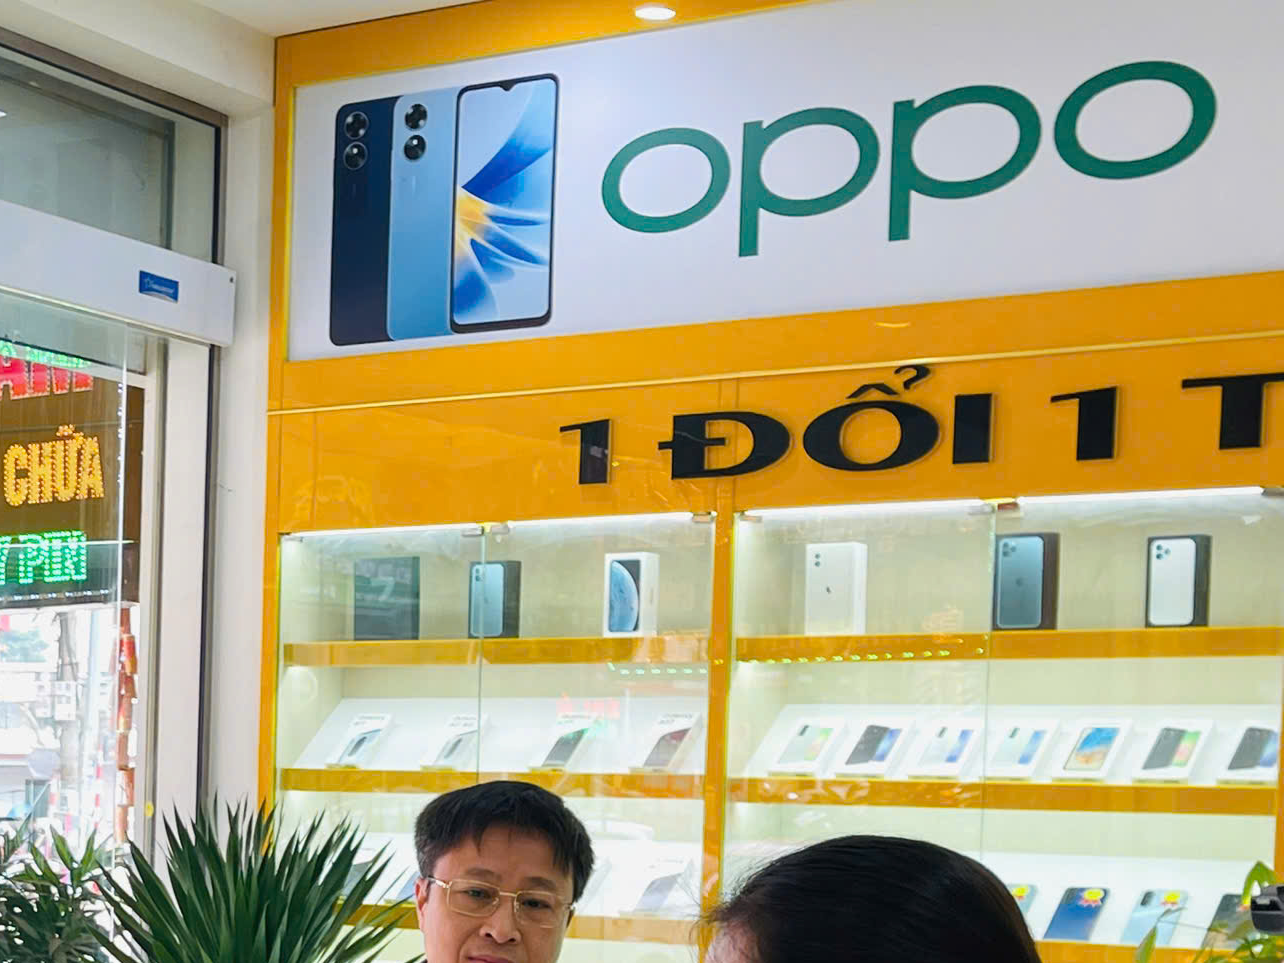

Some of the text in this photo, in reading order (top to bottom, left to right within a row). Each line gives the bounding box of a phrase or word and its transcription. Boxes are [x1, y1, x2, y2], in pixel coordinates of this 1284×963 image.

[3, 424, 105, 507] CHỮA
[559, 419, 613, 485] 1
[658, 364, 996, 480] ĐỔI
[1050, 386, 1118, 461] 1
